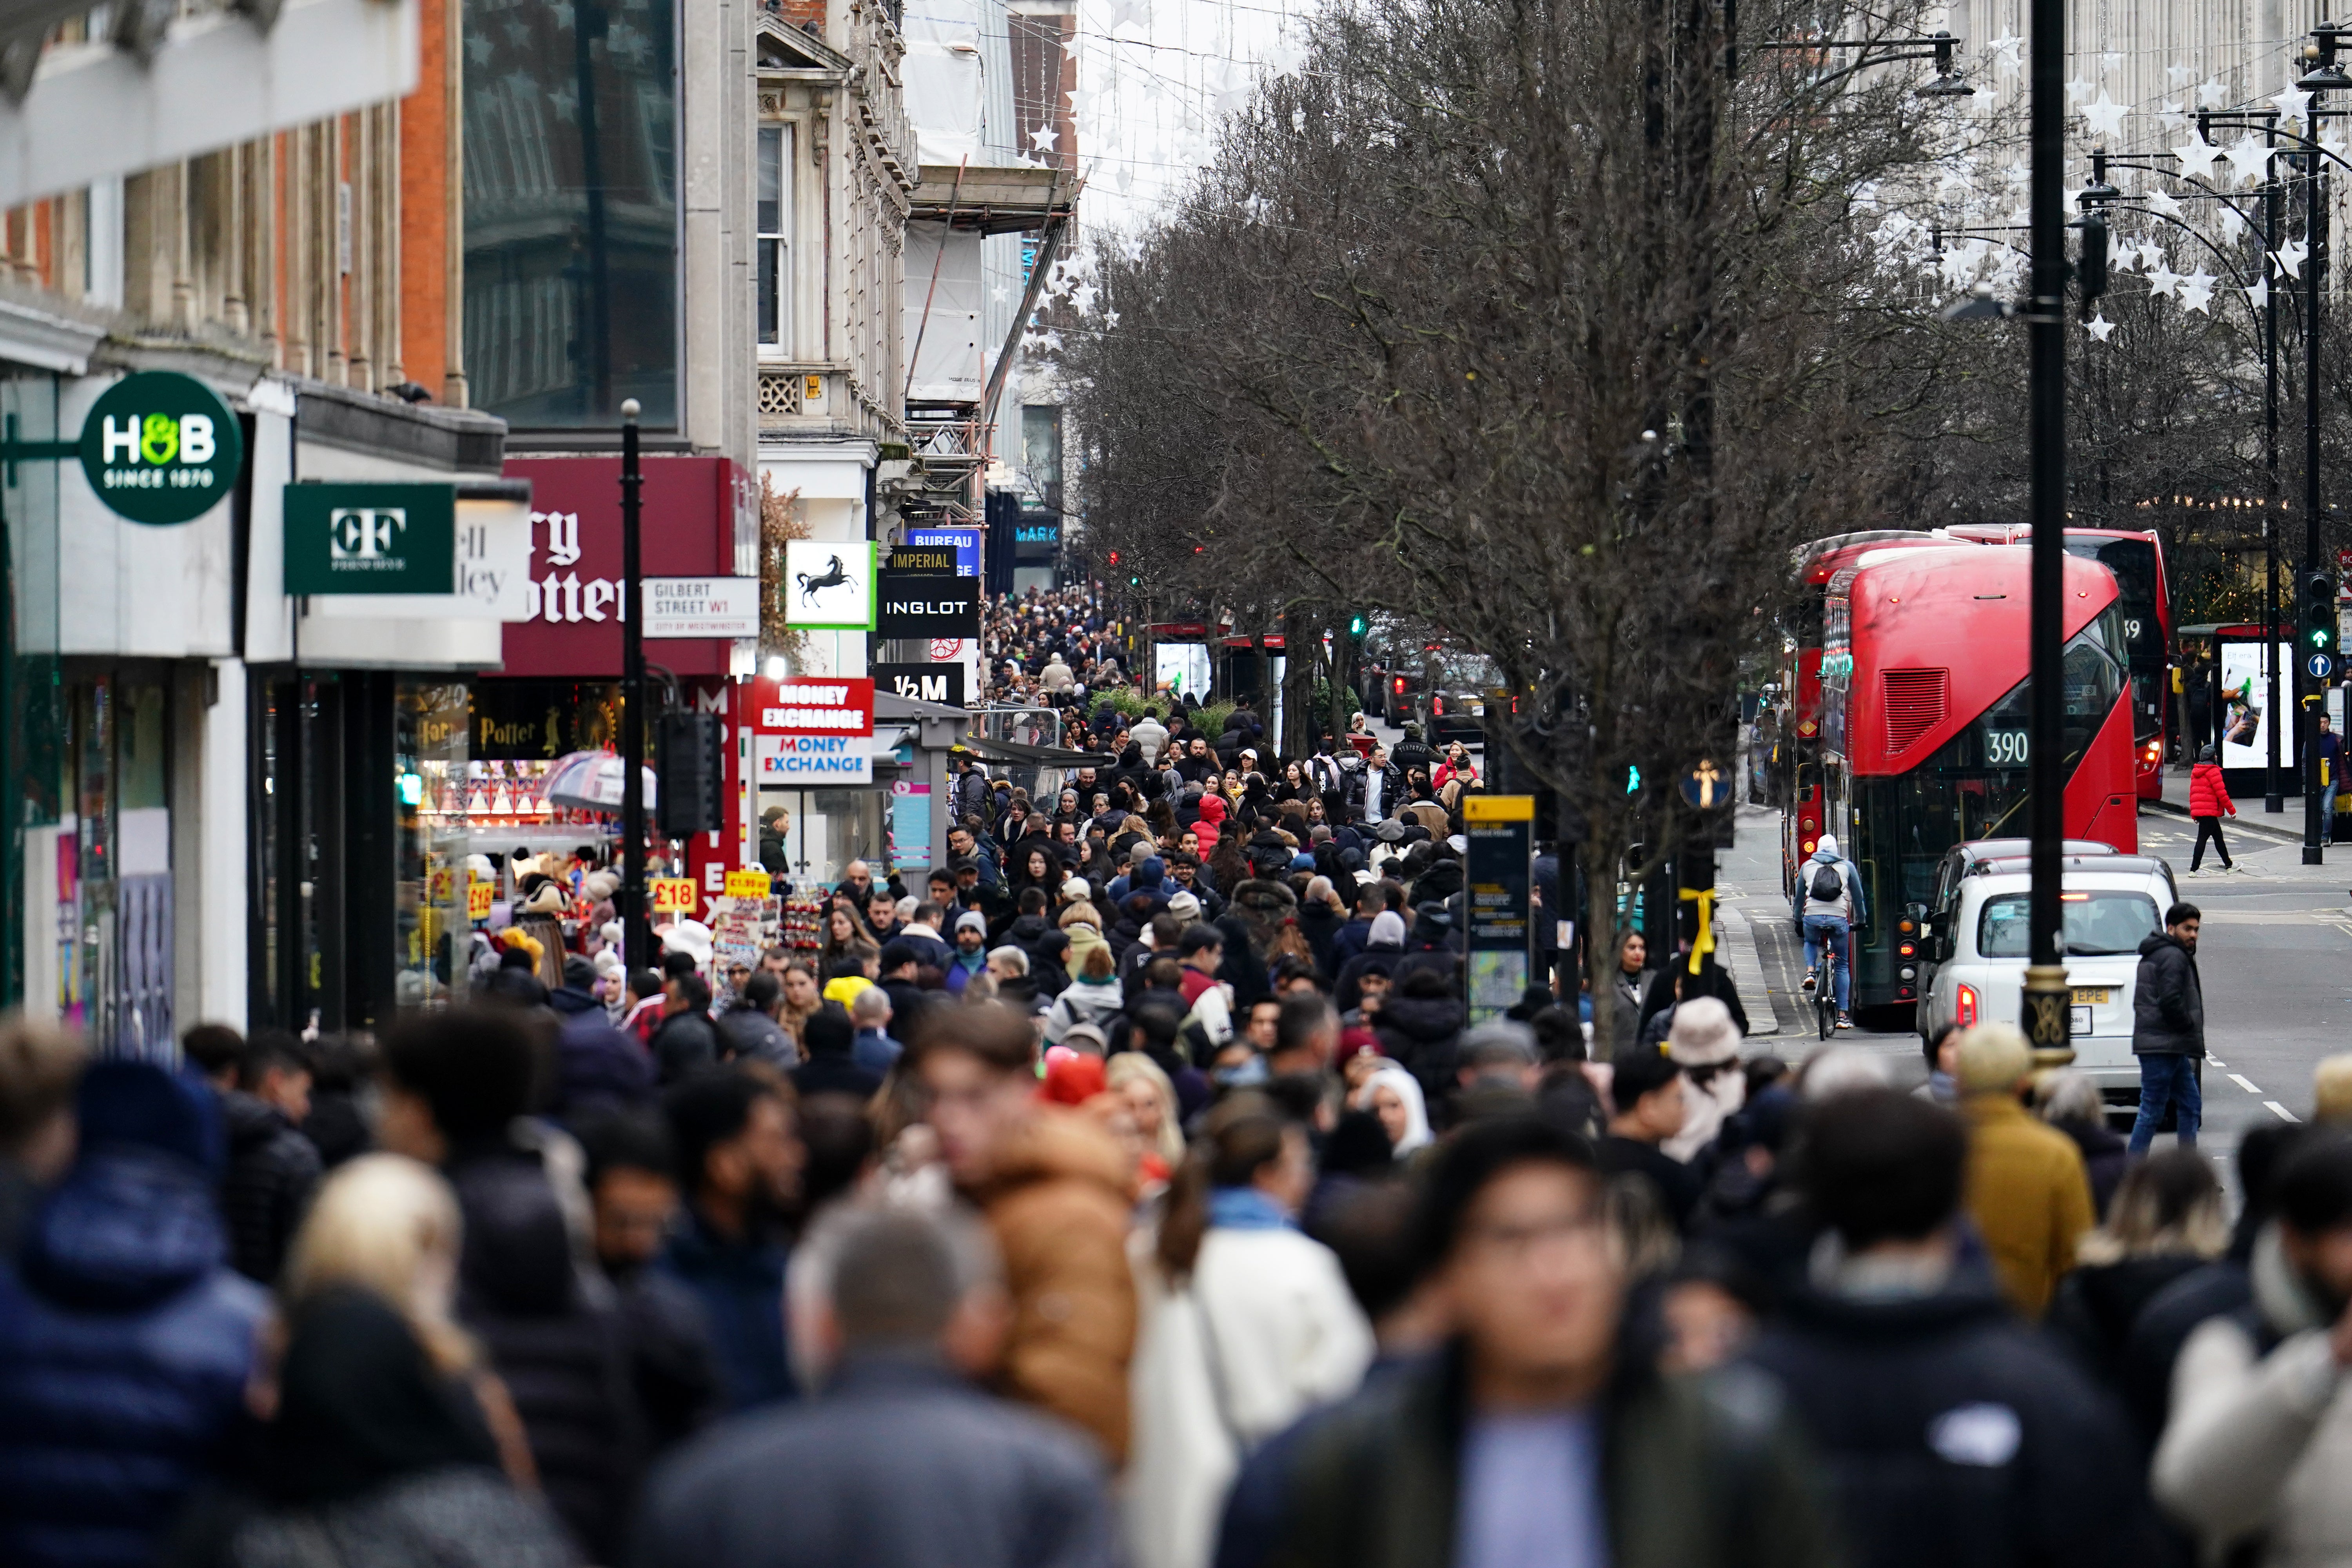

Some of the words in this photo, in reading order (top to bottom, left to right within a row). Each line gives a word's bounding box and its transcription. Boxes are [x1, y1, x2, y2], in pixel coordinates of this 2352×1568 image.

[103, 413, 216, 466] H&B
[103, 468, 164, 488] SINCE
[169, 468, 213, 488] 1870
[530, 511, 581, 566] ry
[915, 535, 972, 548] BUREAU
[893, 554, 950, 568] IMPERIAL
[956, 565, 973, 576] GE
[460, 562, 506, 606] ley
[654, 582, 710, 597] GILBERT
[655, 600, 704, 614] STREET
[708, 600, 728, 613] W1
[887, 601, 968, 614] INGLOT
[655, 622, 673, 631] CITY
[688, 622, 746, 631] WESTMINSTER
[2227, 652, 2236, 661] Elf
[779, 684, 849, 705] MONEY
[762, 708, 864, 729] EXCHANGE
[481, 717, 536, 751] Potter
[780, 737, 847, 753] MONEY
[1989, 732, 2028, 763] 390
[765, 757, 862, 771] EXCHANGE
[655, 883, 691, 904] £18
[2078, 989, 2103, 1002] EPE
